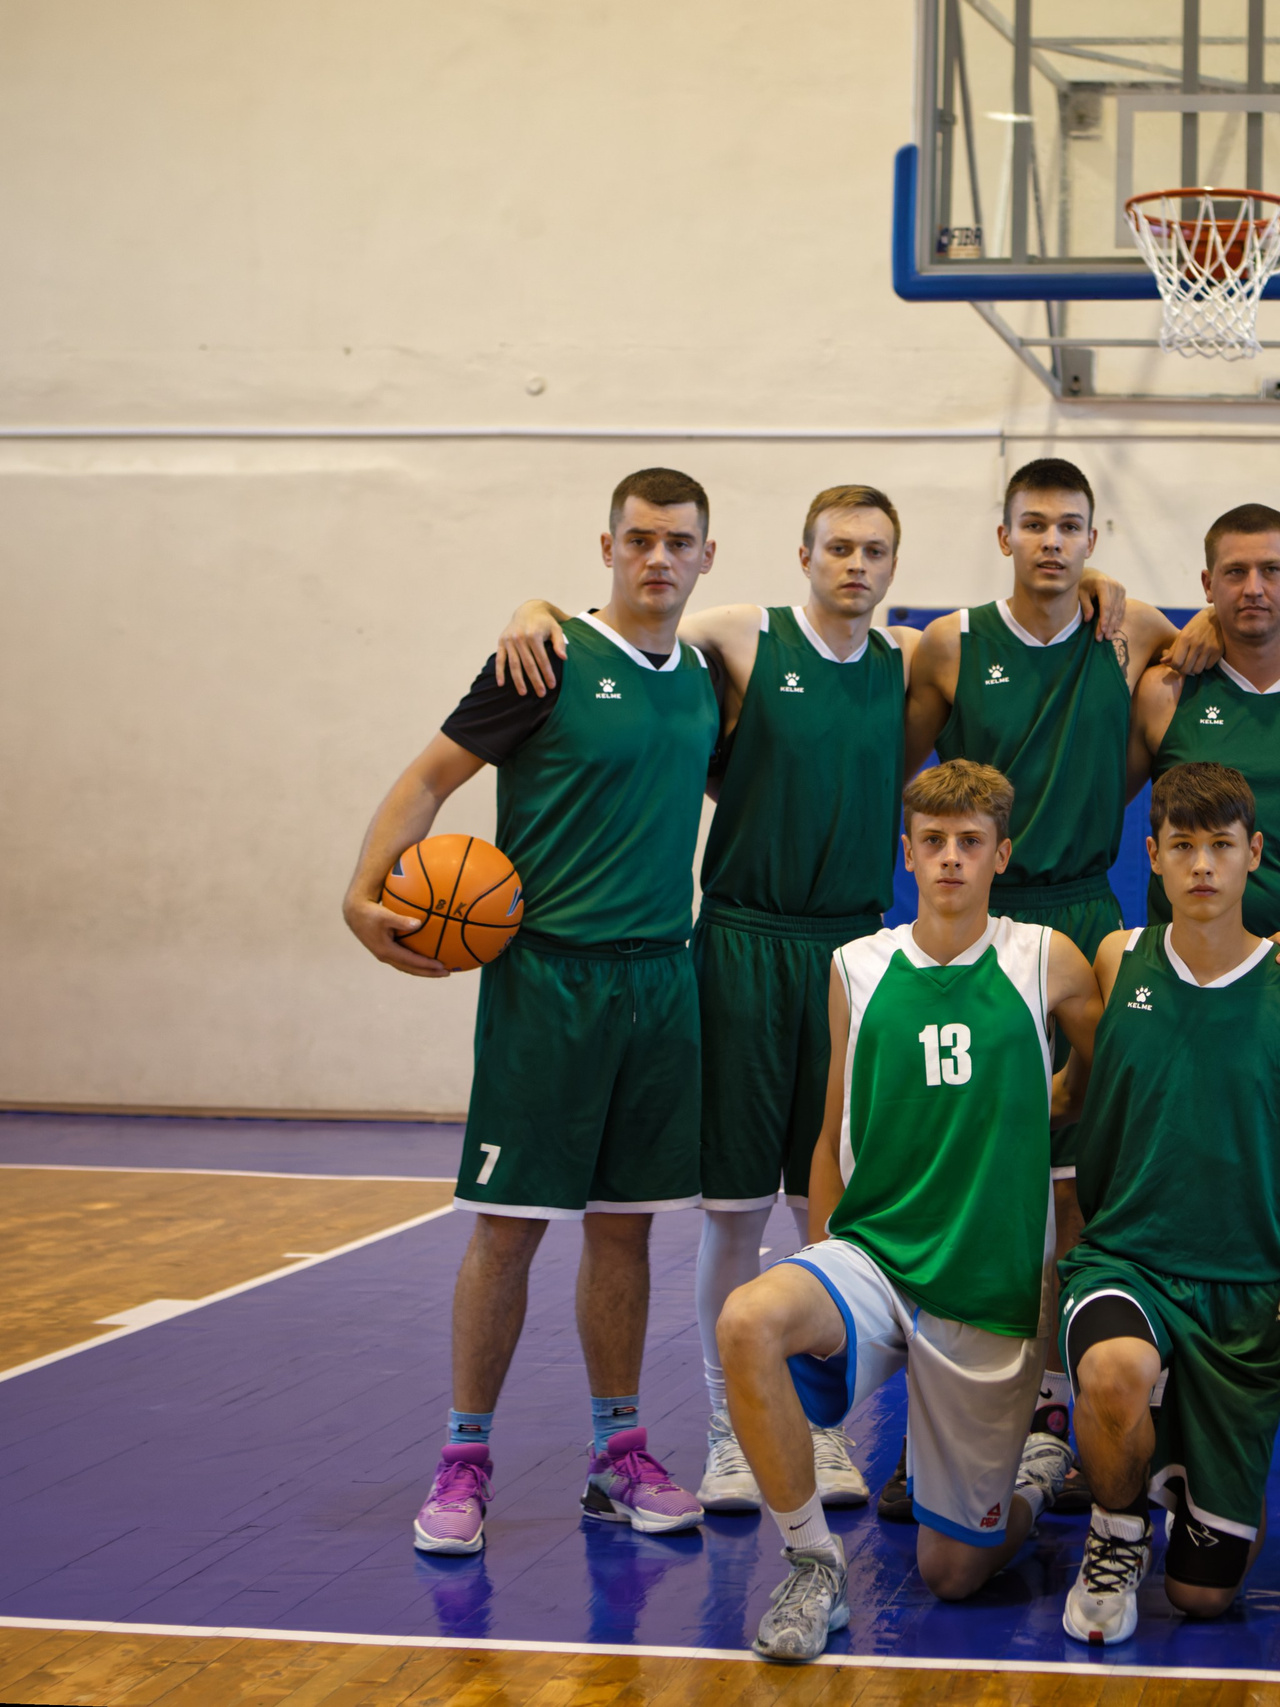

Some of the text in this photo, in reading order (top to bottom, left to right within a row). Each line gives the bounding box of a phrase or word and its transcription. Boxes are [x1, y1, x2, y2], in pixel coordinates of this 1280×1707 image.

[985, 676, 1010, 685] KELME
[595, 692, 622, 700] KELME
[1199, 718, 1224, 726] KELME
[1127, 1002, 1153, 1011] KELME
[918, 1023, 972, 1087] 13
[475, 1142, 502, 1185] 7
